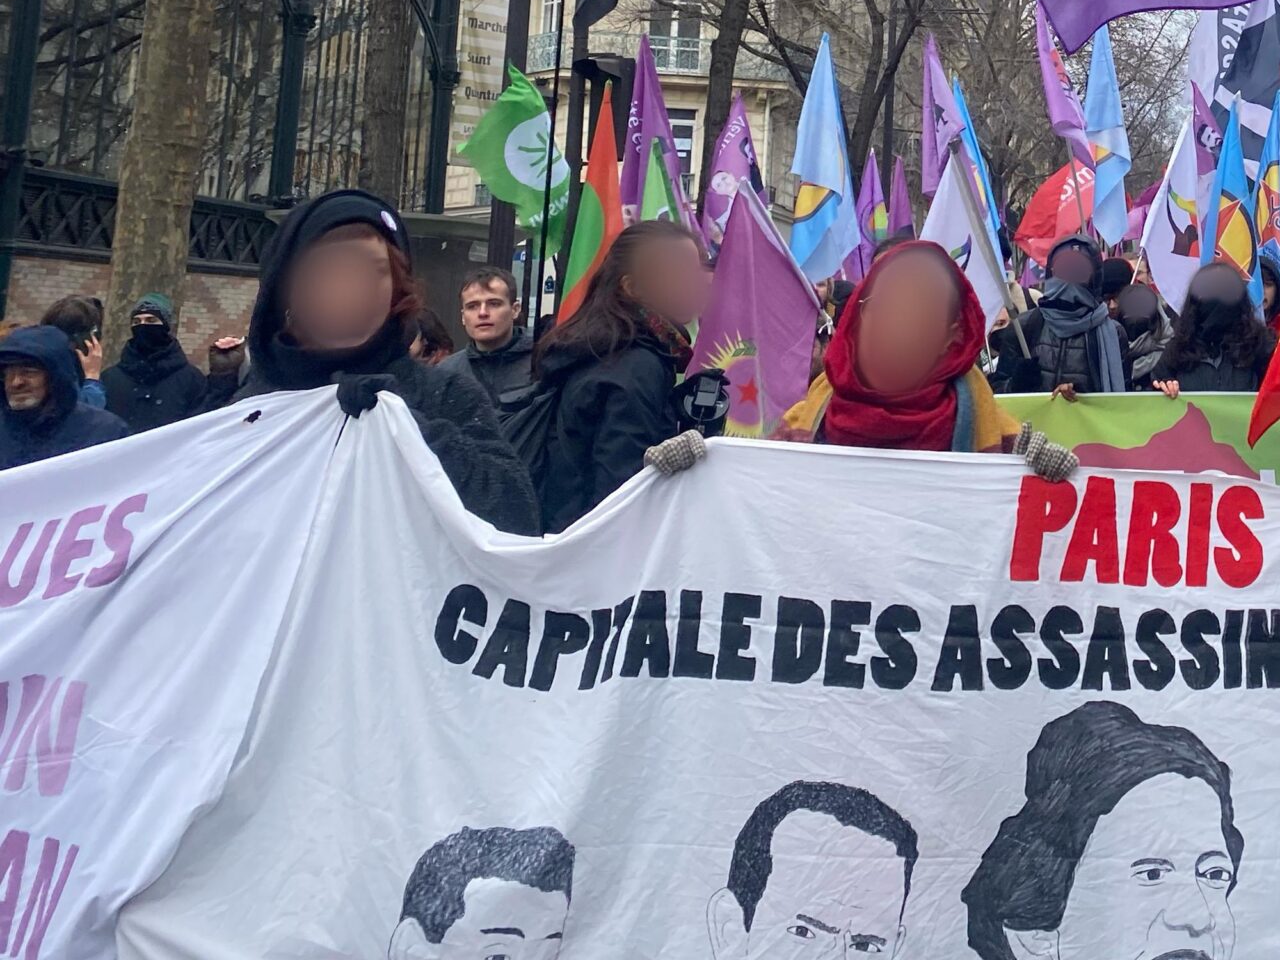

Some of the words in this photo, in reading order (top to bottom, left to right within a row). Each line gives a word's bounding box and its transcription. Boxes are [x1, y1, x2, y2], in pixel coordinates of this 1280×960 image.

[1009, 474, 1265, 588] PARIS
[434, 584, 762, 691] CAPITALE
[771, 595, 921, 690] DES
